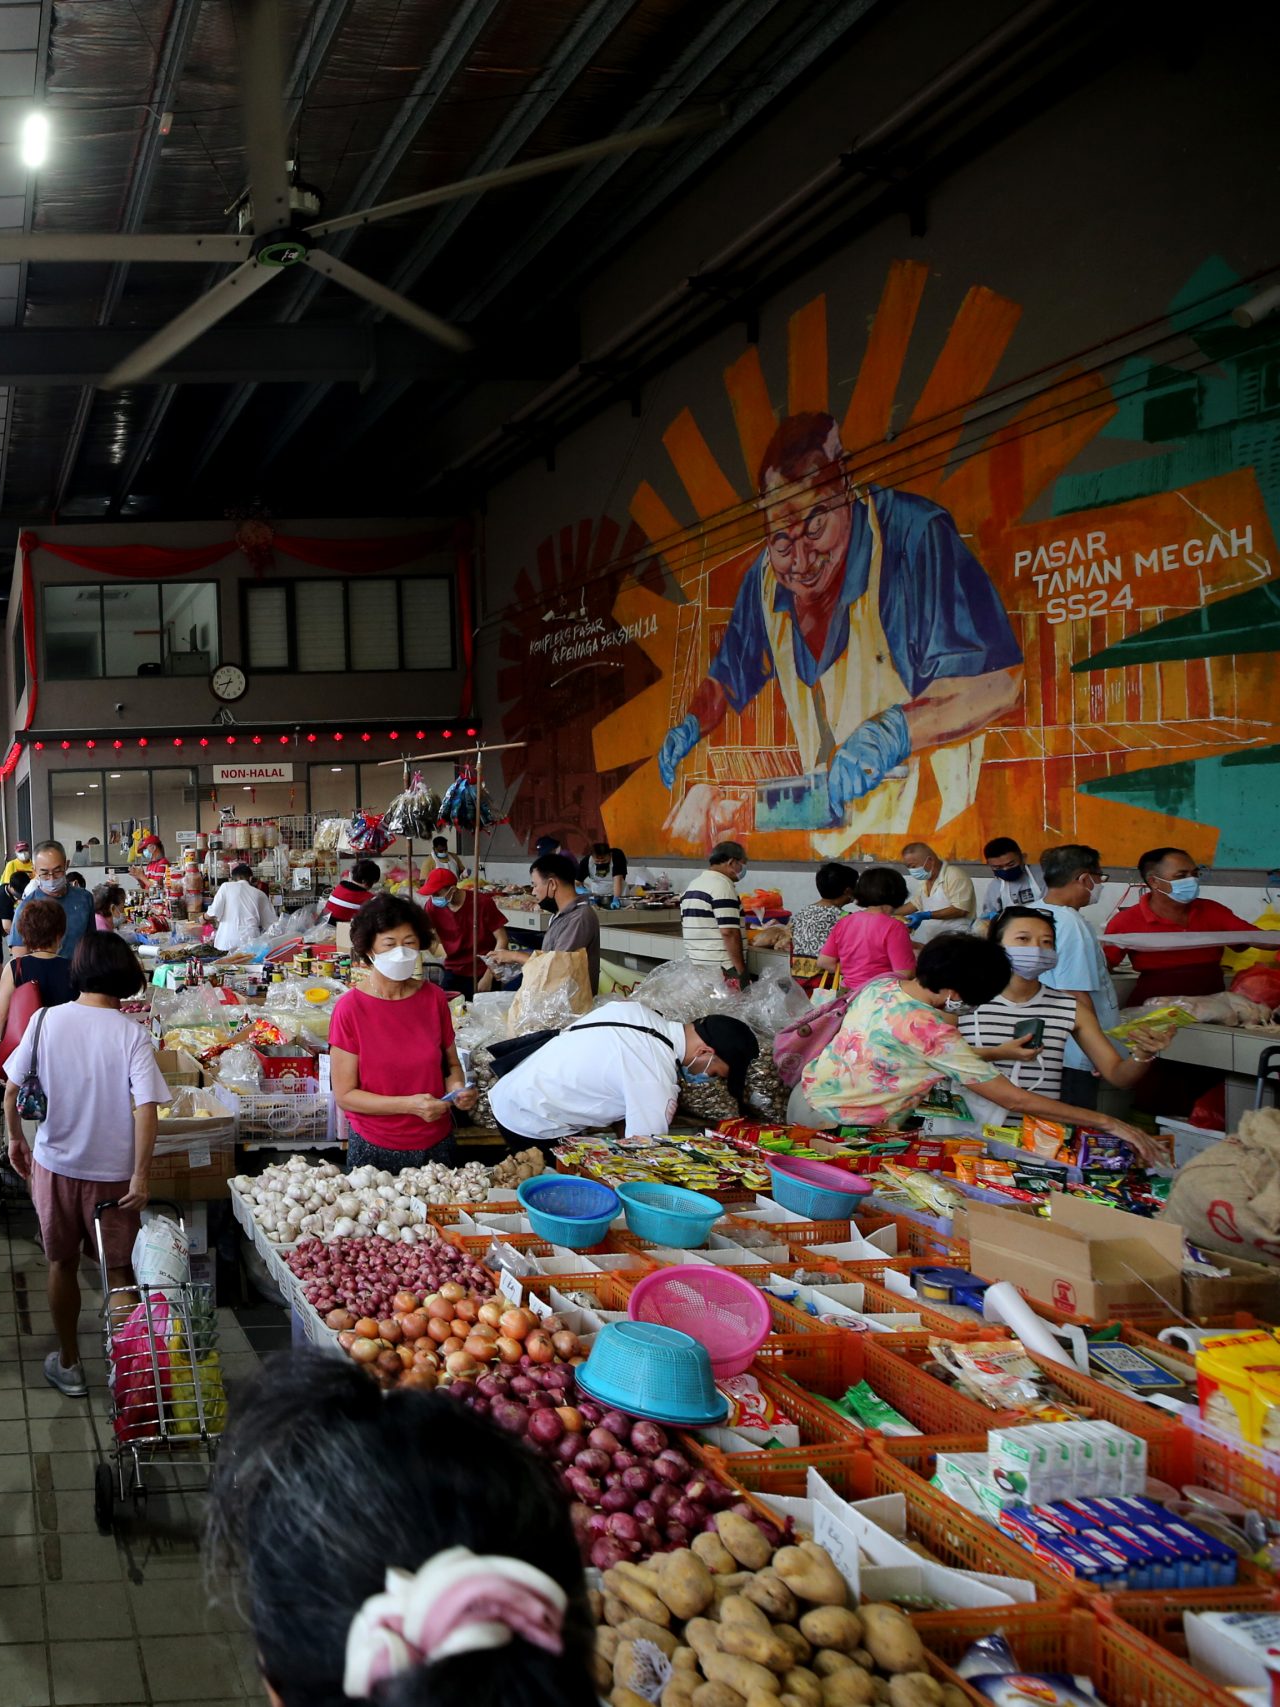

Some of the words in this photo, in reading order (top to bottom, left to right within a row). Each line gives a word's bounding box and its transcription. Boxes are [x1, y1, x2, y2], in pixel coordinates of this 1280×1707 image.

[1014, 530, 1108, 577] PASAR
[1033, 556, 1122, 599] TAMAN
[1134, 525, 1253, 577] MEGAH
[1046, 583, 1134, 625] SS24
[529, 628, 571, 656] KOMPLEKS
[573, 617, 606, 641] PASAR
[560, 638, 599, 662] PENIAGA
[601, 618, 642, 651] SEKSYEN
[643, 613, 658, 638] 14
[221, 768, 285, 779] NON-HALAL
